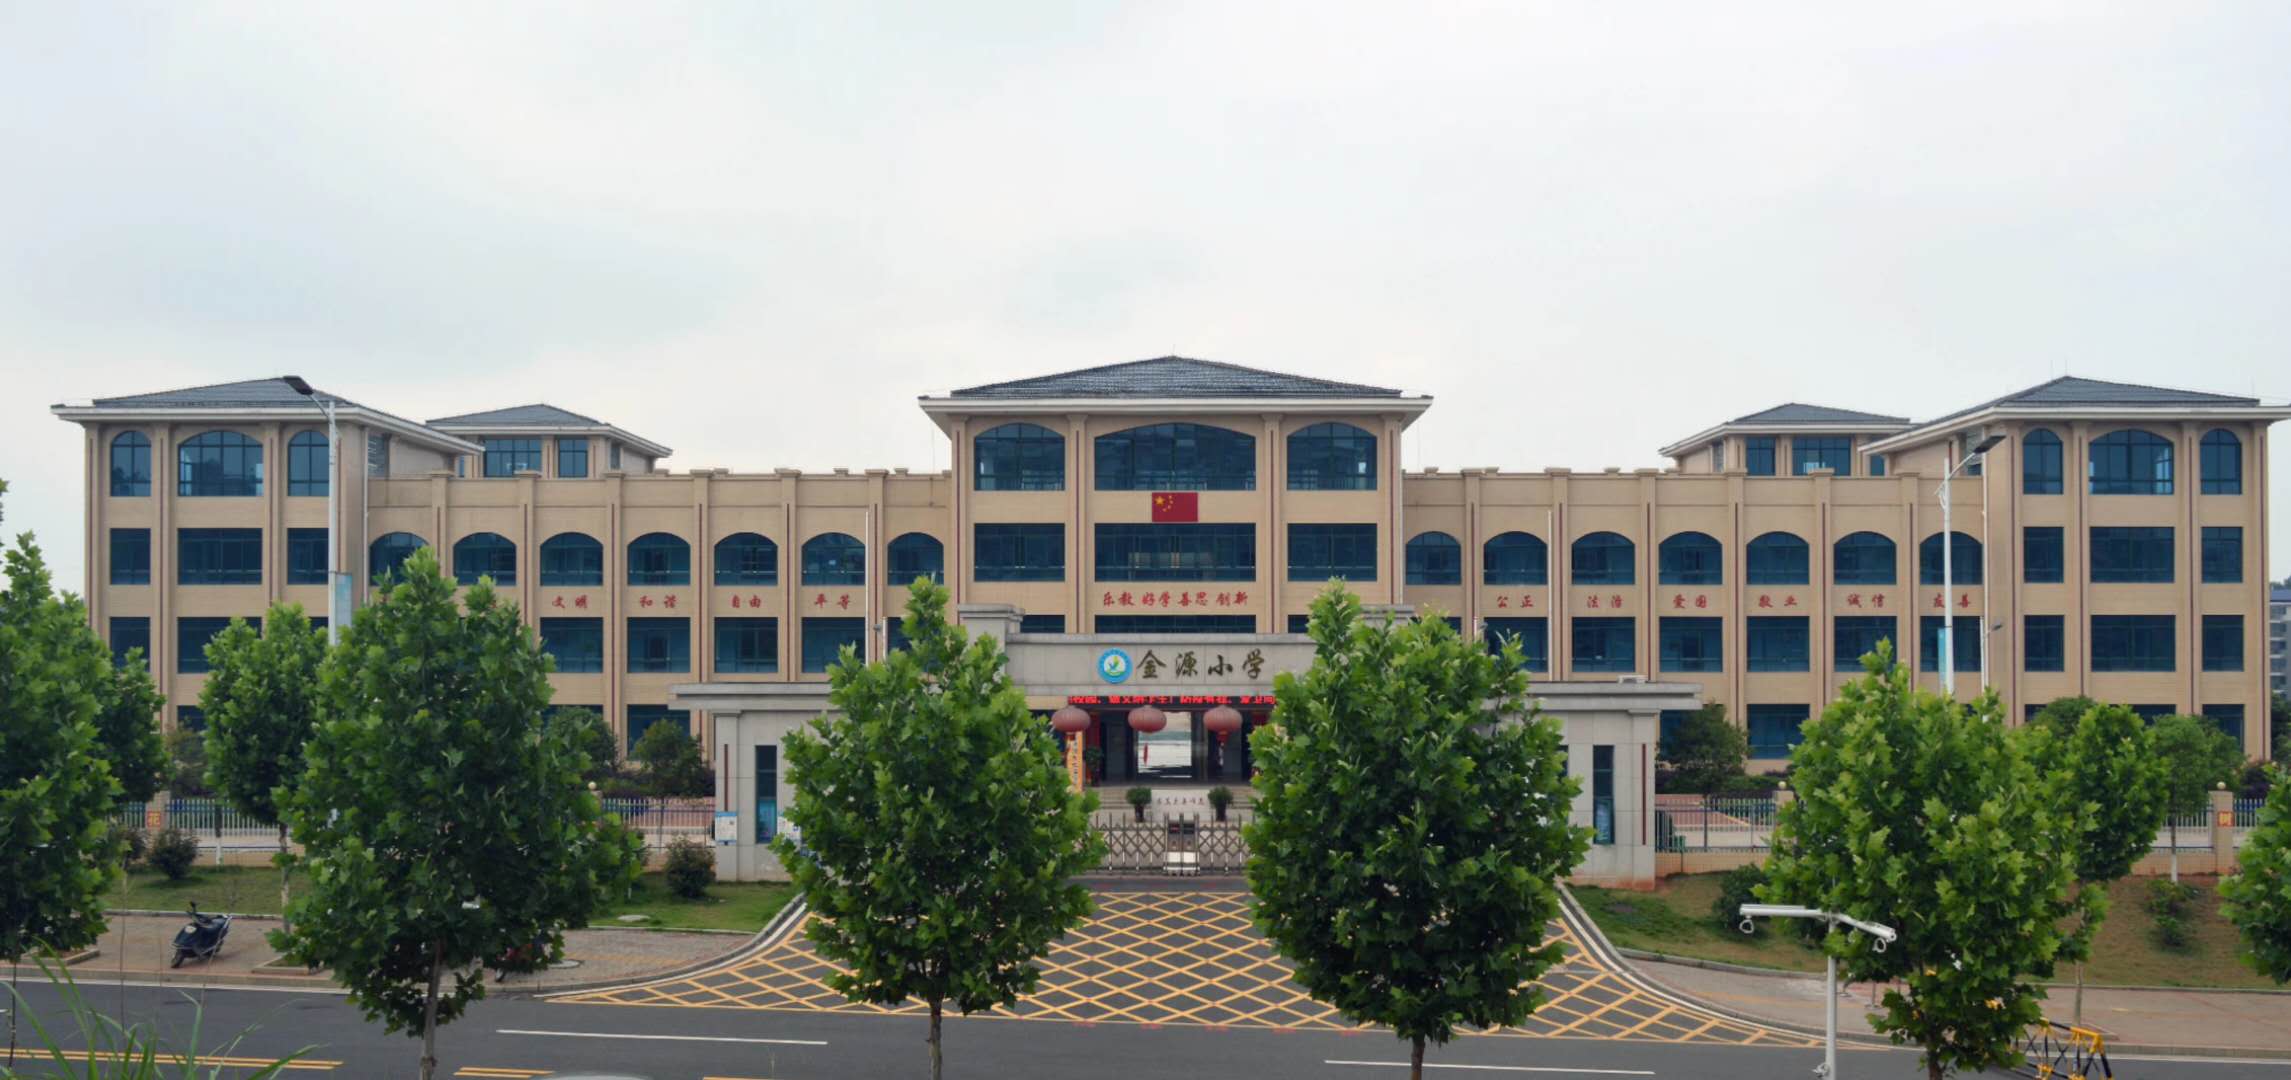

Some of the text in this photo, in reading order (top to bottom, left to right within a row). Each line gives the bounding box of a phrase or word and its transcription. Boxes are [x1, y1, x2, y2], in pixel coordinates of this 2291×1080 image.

[552, 594, 588, 609] 文明
[639, 594, 677, 609] 和谐
[731, 594, 761, 609] 自由
[814, 593, 850, 610] 平等
[1497, 595, 1533, 609] 公正
[1587, 595, 1622, 609] 法治
[1673, 595, 1707, 609] 爱国
[1758, 595, 1797, 609] 敬业
[1848, 594, 1885, 609] 诚信
[1933, 593, 1971, 609] 友善
[1136, 648, 1265, 679] 金源小学
